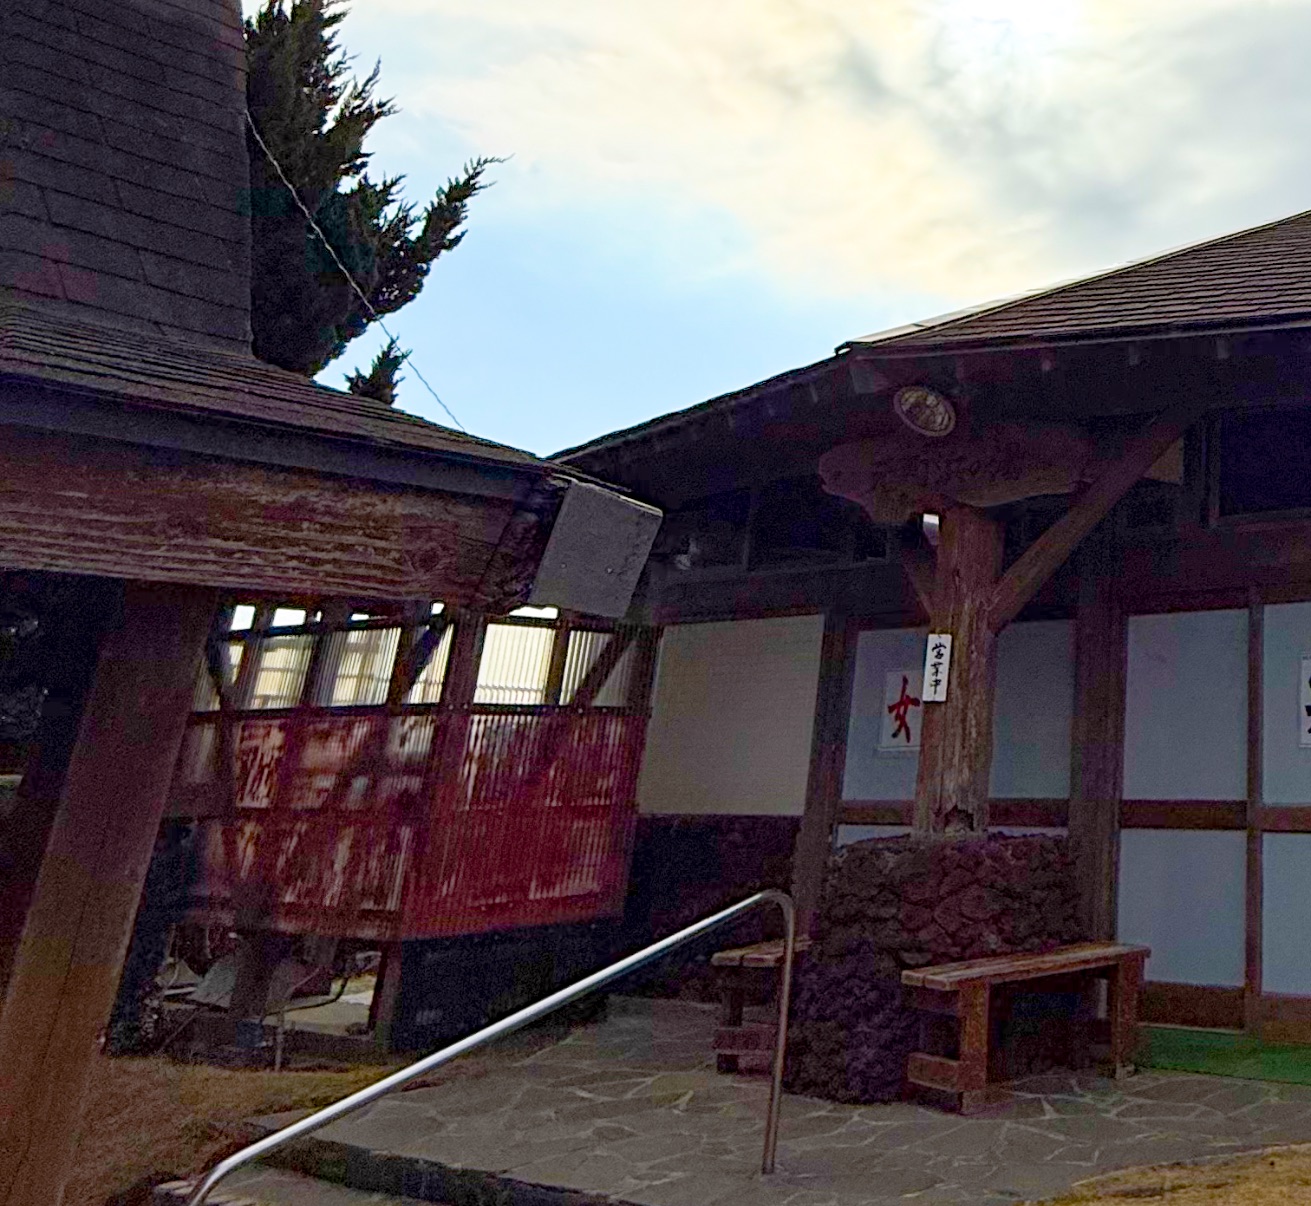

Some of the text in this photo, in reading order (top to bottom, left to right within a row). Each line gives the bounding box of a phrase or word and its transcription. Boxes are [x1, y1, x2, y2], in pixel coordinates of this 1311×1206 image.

[930, 643, 947, 695] 営業中
[888, 675, 921, 743] 女
